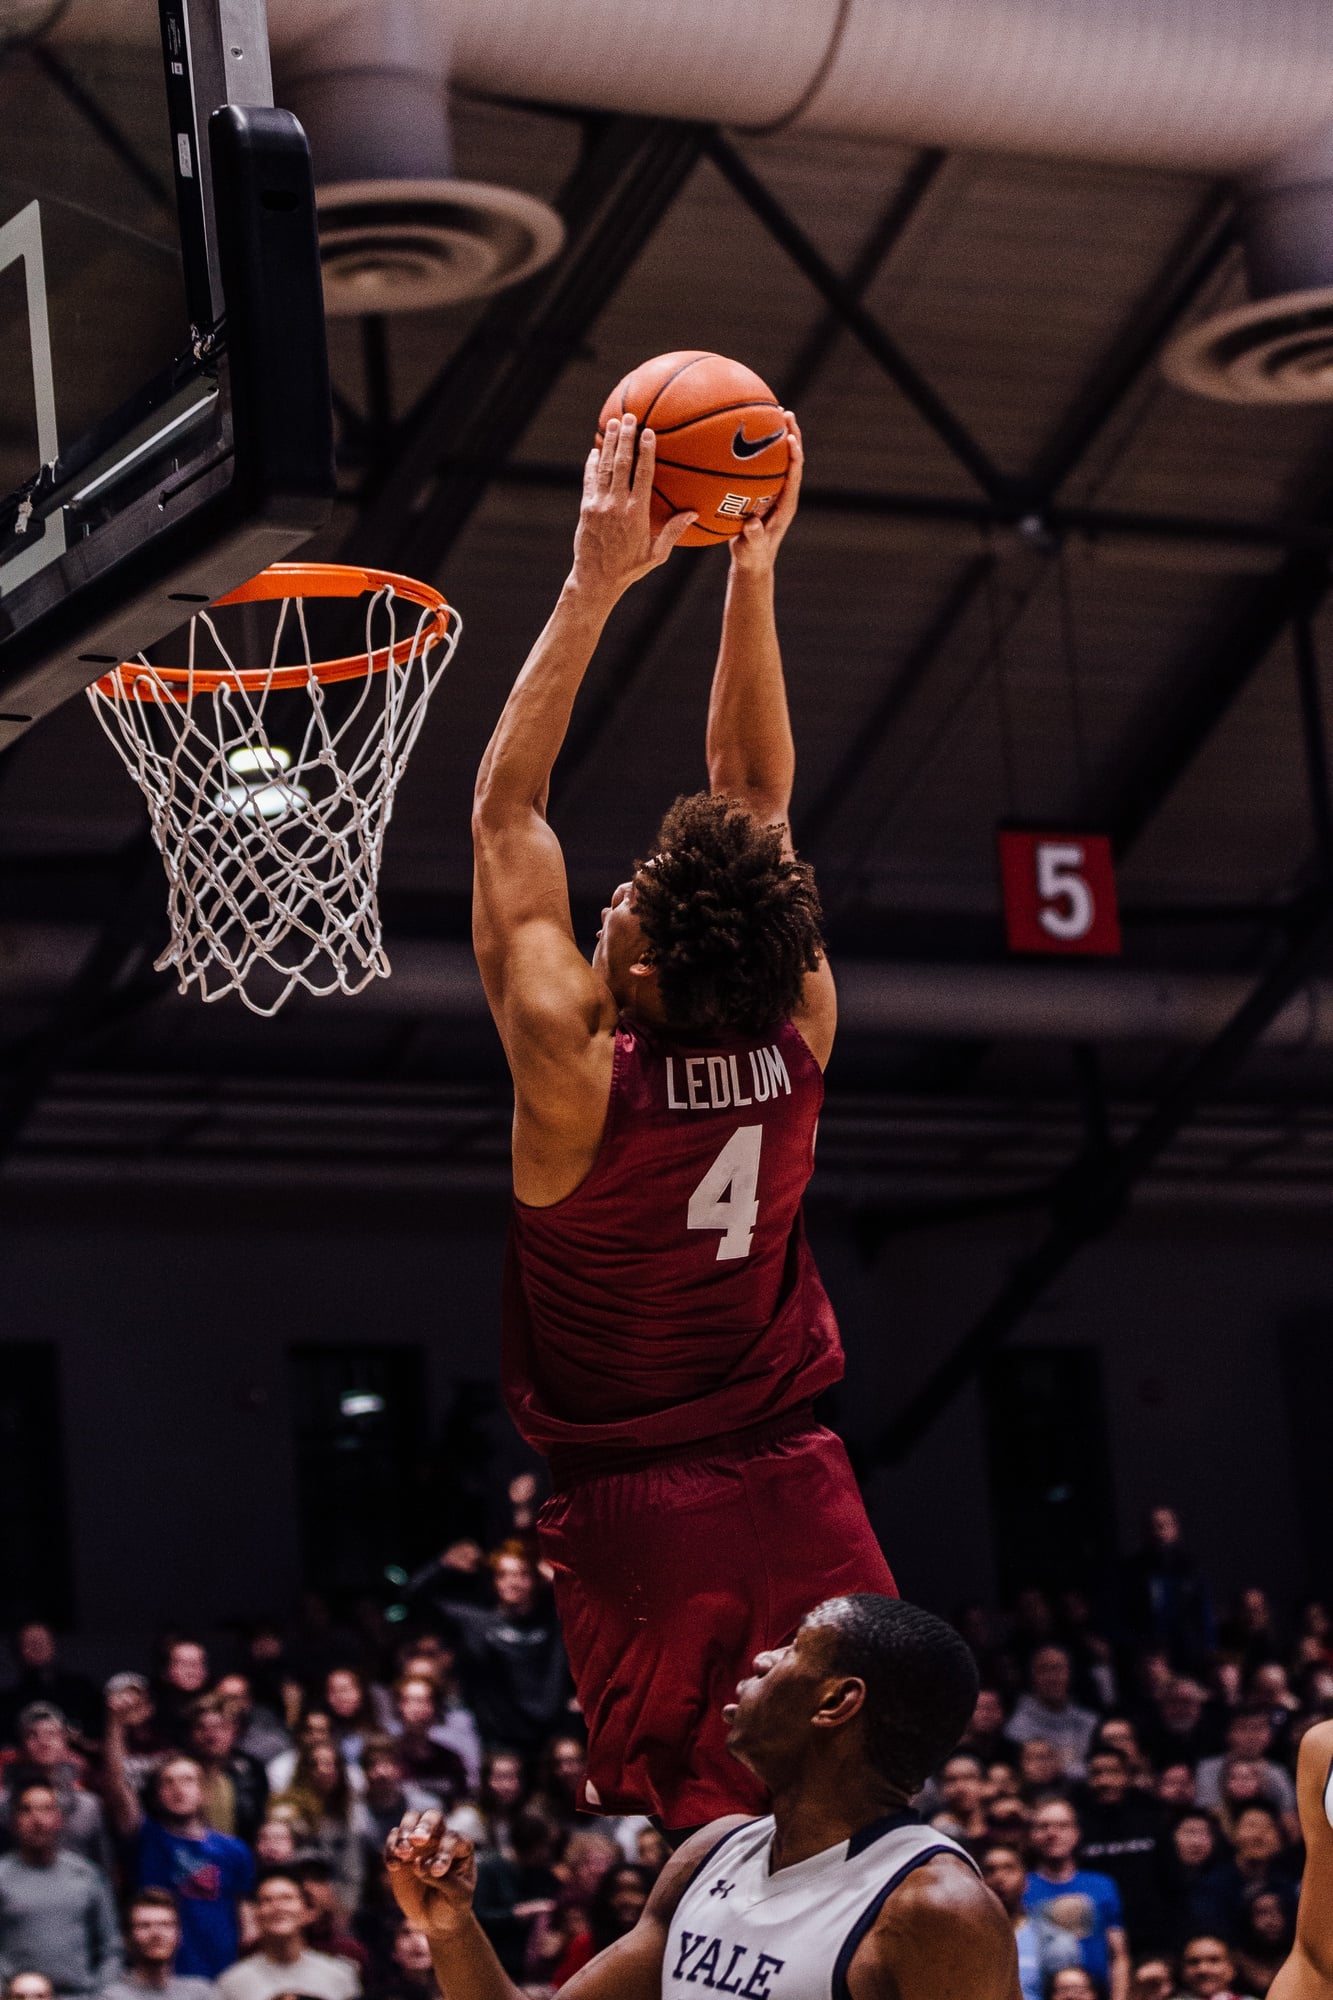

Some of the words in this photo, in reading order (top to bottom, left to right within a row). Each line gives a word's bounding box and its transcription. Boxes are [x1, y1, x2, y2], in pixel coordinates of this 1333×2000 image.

[1037, 843, 1093, 938] 5
[666, 1045, 791, 1109] LEDLUM
[687, 1124, 763, 1260] 4
[672, 1931, 785, 2000] YALE
